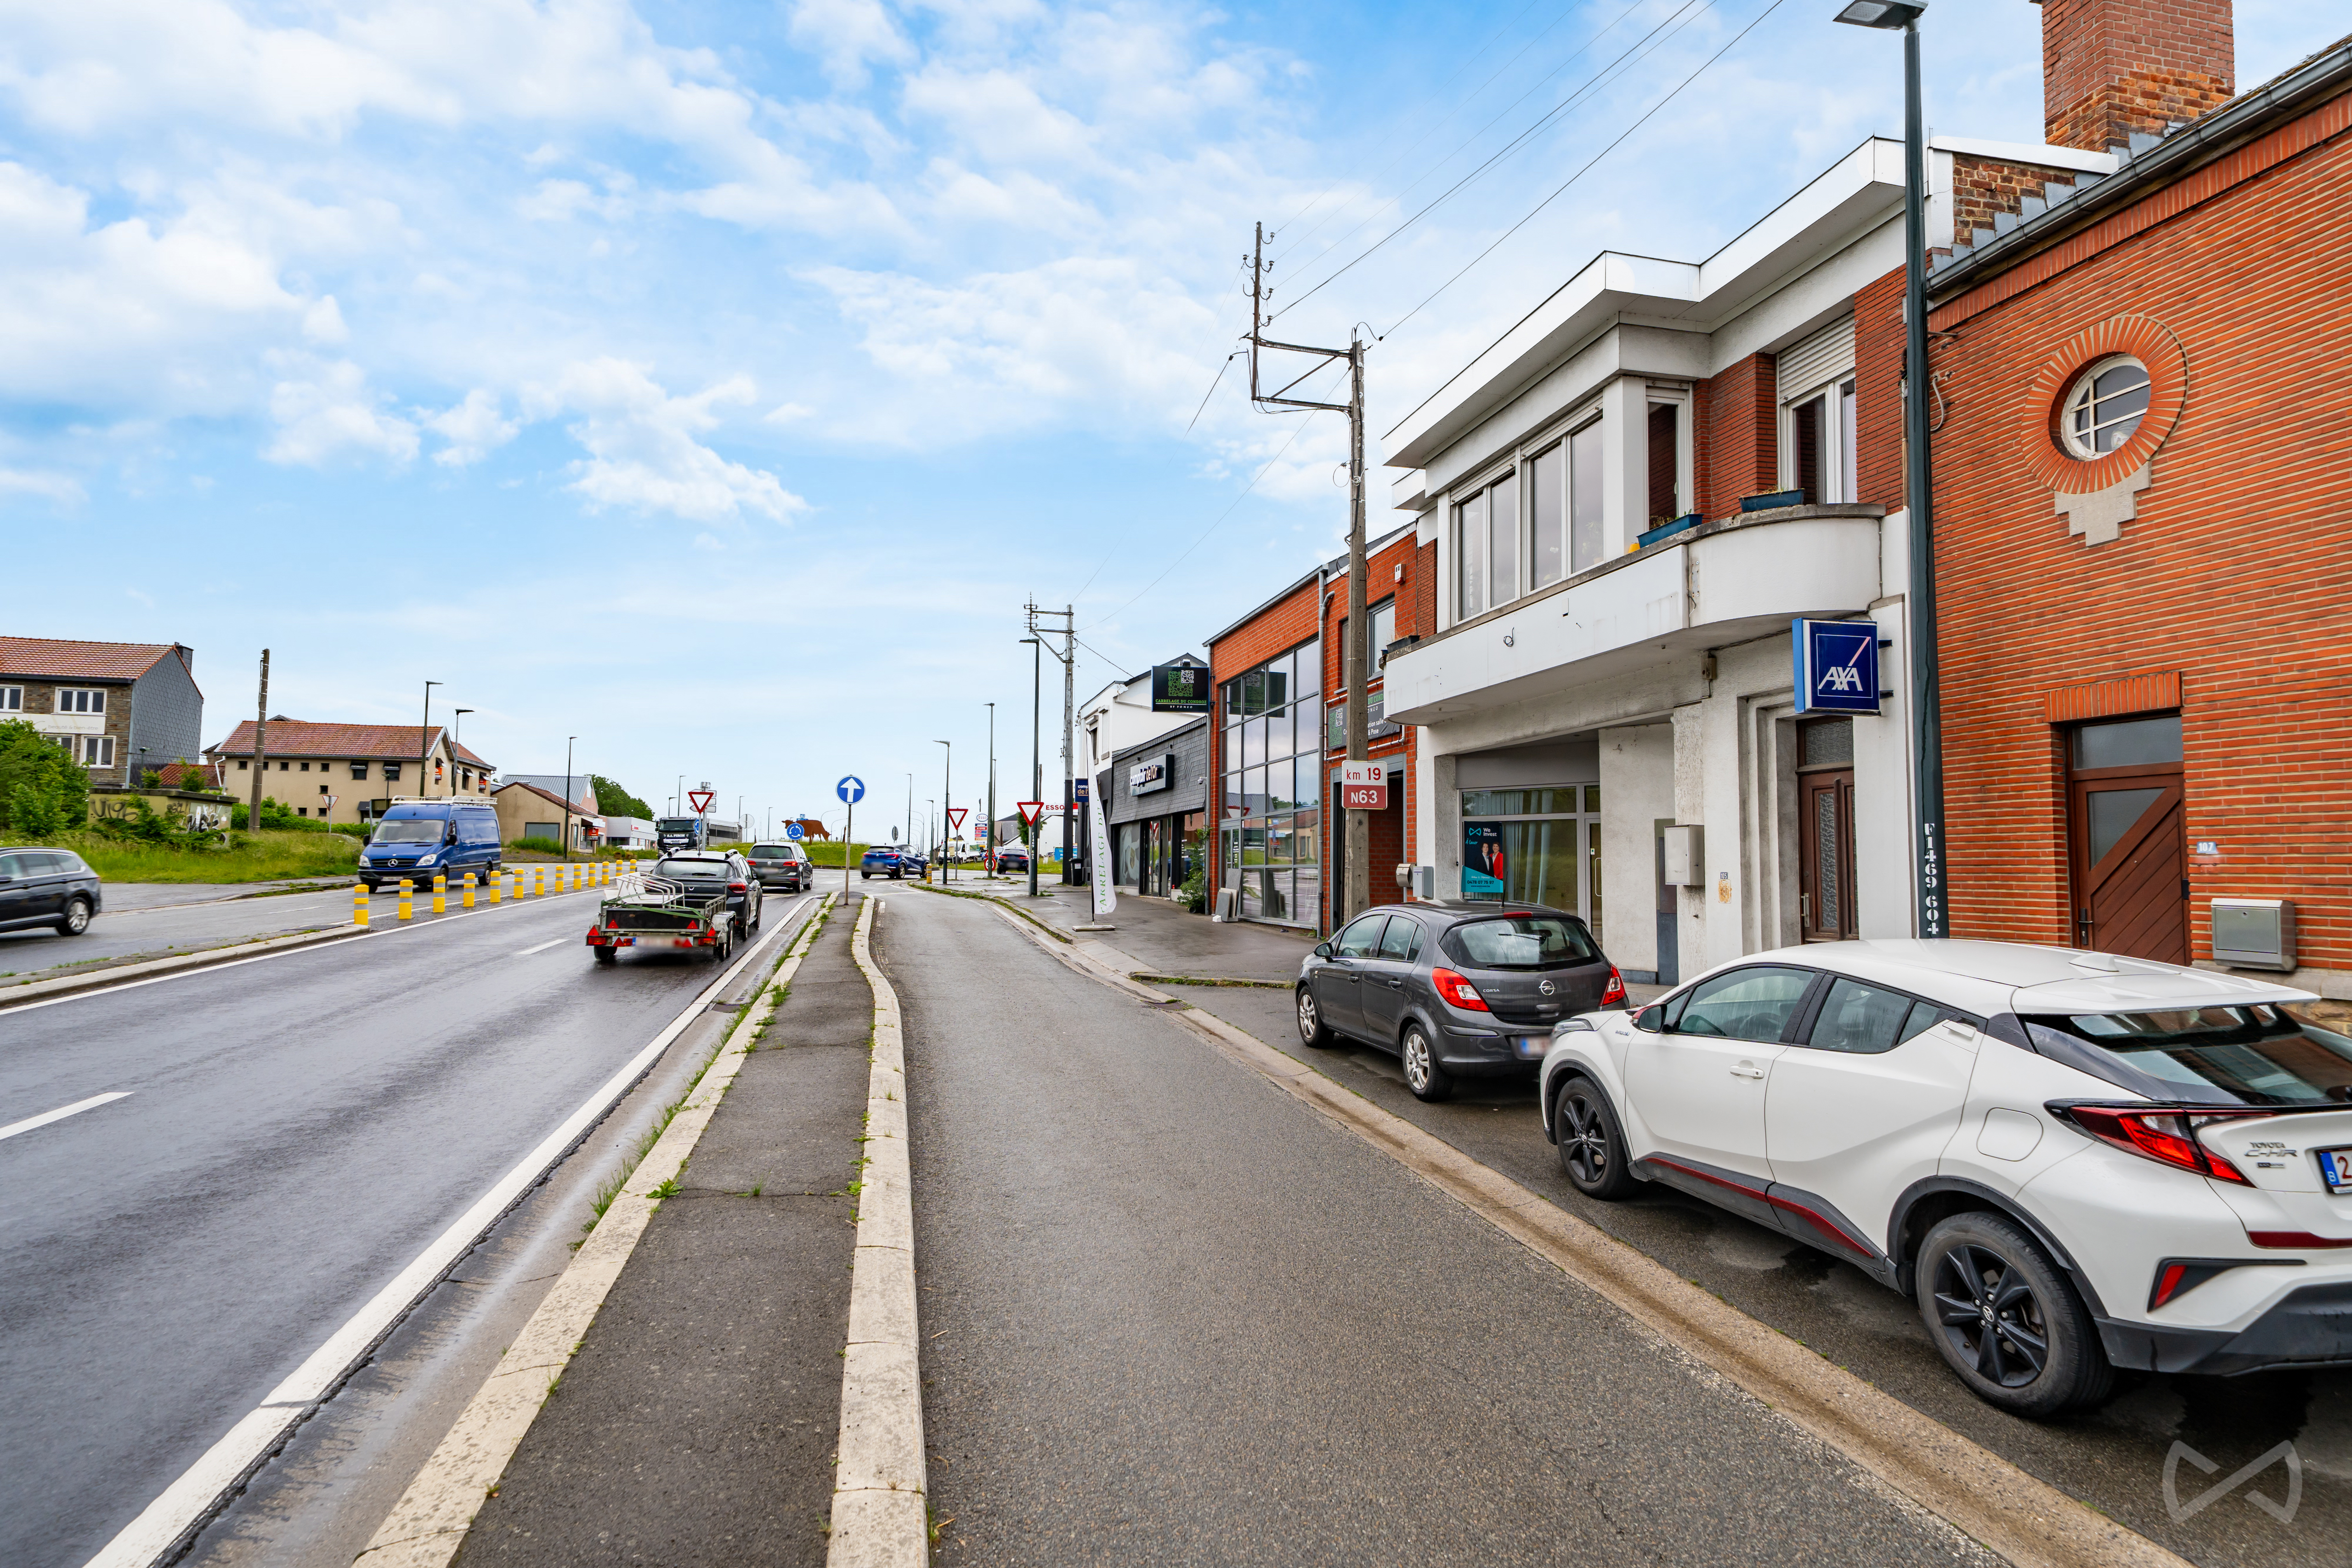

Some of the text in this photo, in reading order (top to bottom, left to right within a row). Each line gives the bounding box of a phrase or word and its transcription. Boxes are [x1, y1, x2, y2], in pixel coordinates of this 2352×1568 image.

[1818, 667, 1863, 691] AXA
[1374, 694, 1384, 702] COND
[1130, 768, 1146, 786] comptoir
[1146, 766, 1151, 781] de
[1346, 767, 1381, 781] km 19
[1351, 790, 1378, 804] N63
[2199, 843, 2214, 851] 107
[1924, 823, 1937, 889] F1469
[1925, 895, 1939, 934] 604
[2327, 1171, 2337, 1182] B
